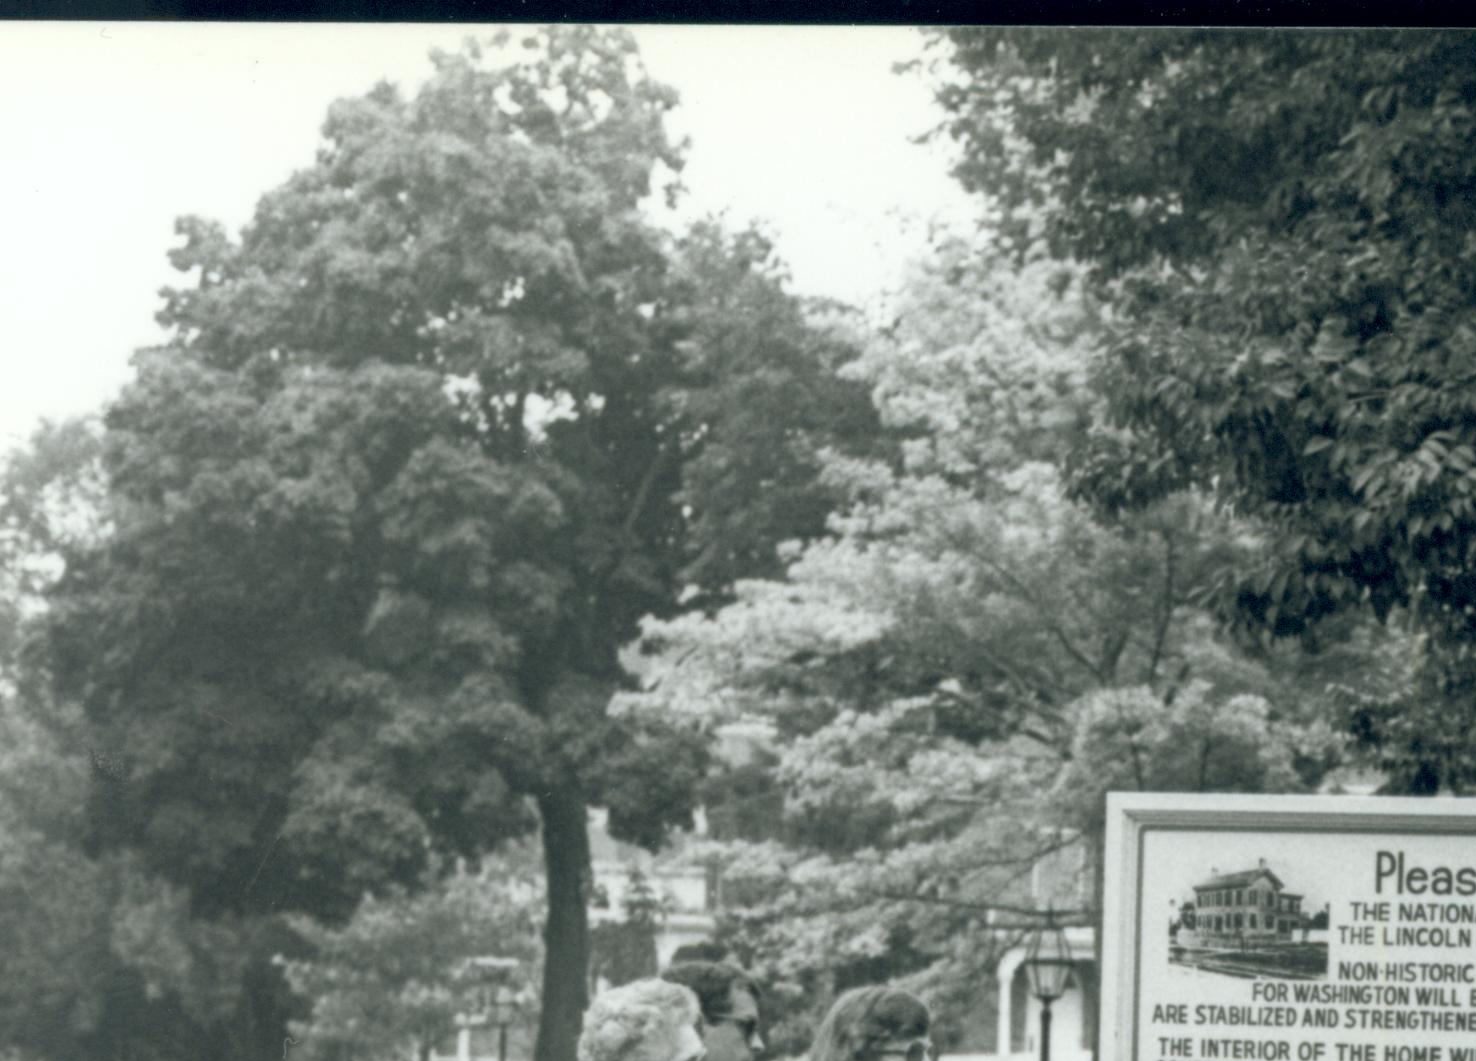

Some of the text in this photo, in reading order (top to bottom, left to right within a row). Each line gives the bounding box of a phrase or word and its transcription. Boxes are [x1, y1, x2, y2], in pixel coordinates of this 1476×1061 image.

[1350, 902, 1389, 920] THE
[1337, 925, 1373, 944] THE
[1383, 927, 1470, 947] LINCOLN
[1339, 962, 1473, 982] NON-HISTORIC
[1252, 983, 1287, 1001] FOR
[1294, 985, 1408, 1004] WASHINGTON
[1415, 988, 1460, 1006] WILL
[1152, 1004, 1187, 1023] ARE
[1195, 1005, 1296, 1025] STABILIZED
[1302, 1009, 1338, 1027] AND
[1158, 1037, 1191, 1056] THE
[1201, 1039, 1289, 1060] INTERIOR
[1297, 1042, 1324, 1061] OF
[1335, 1043, 1375, 1061] THE
